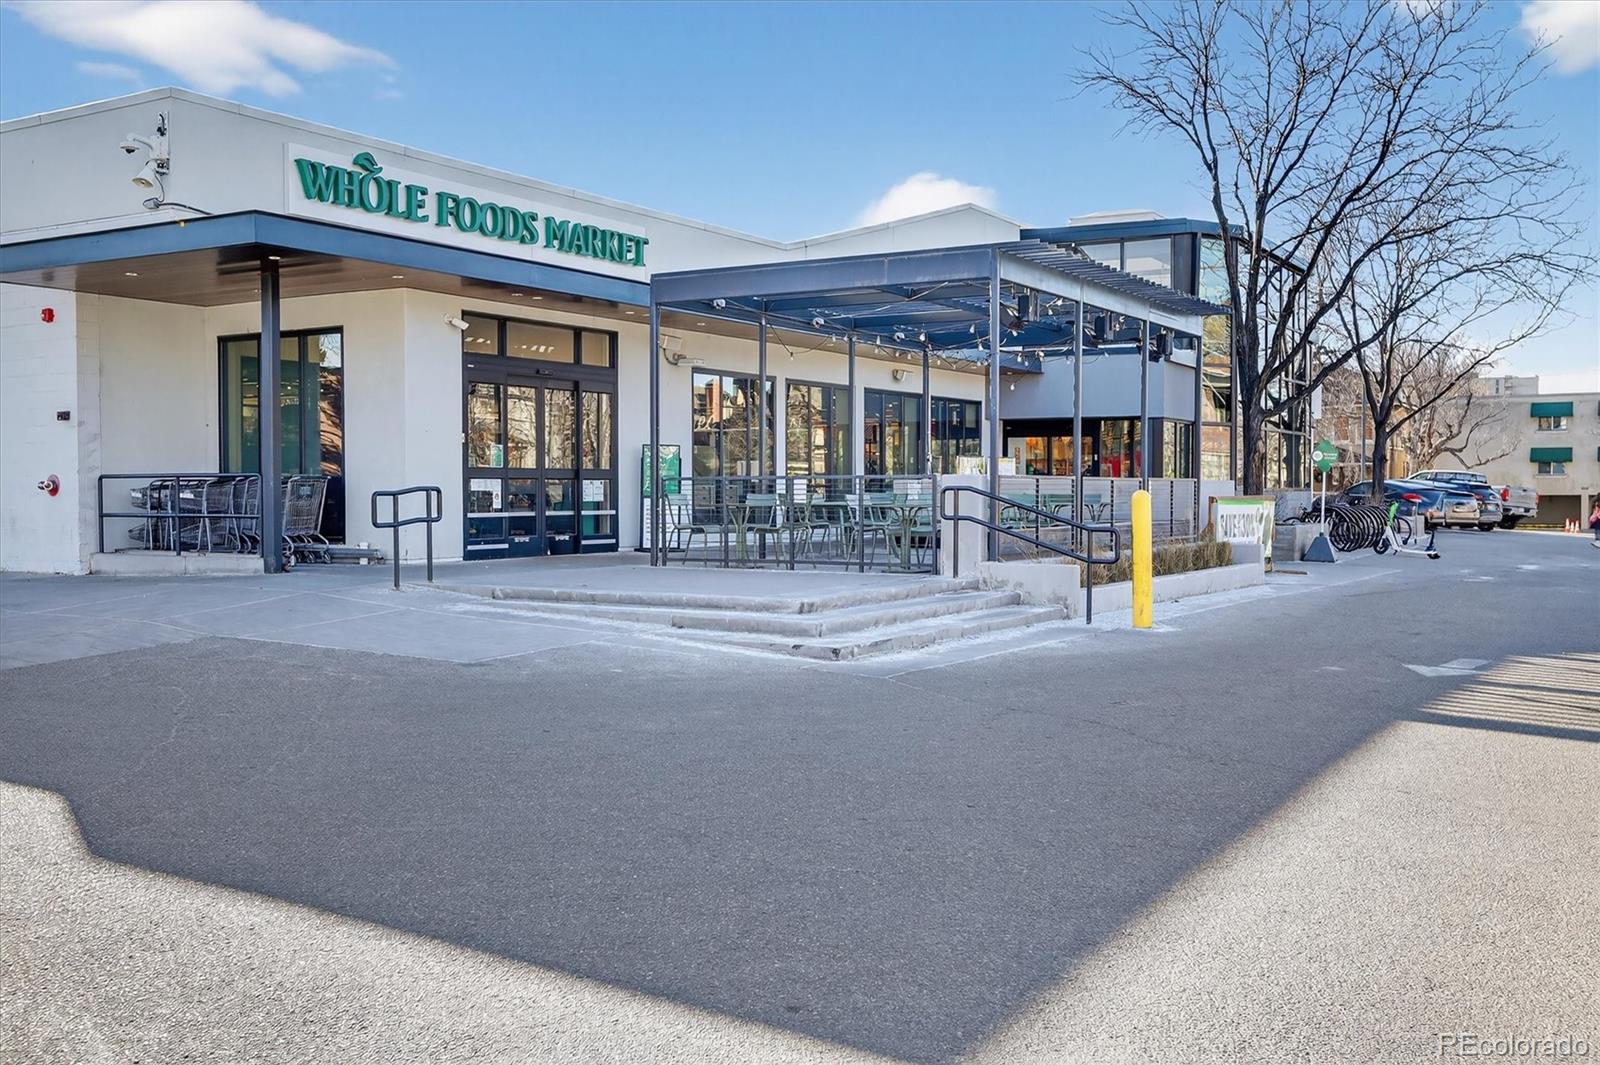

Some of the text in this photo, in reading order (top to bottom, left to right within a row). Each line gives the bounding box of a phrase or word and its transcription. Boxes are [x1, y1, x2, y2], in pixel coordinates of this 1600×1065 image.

[295, 153, 650, 267] WHOLE FOODS MARKET
